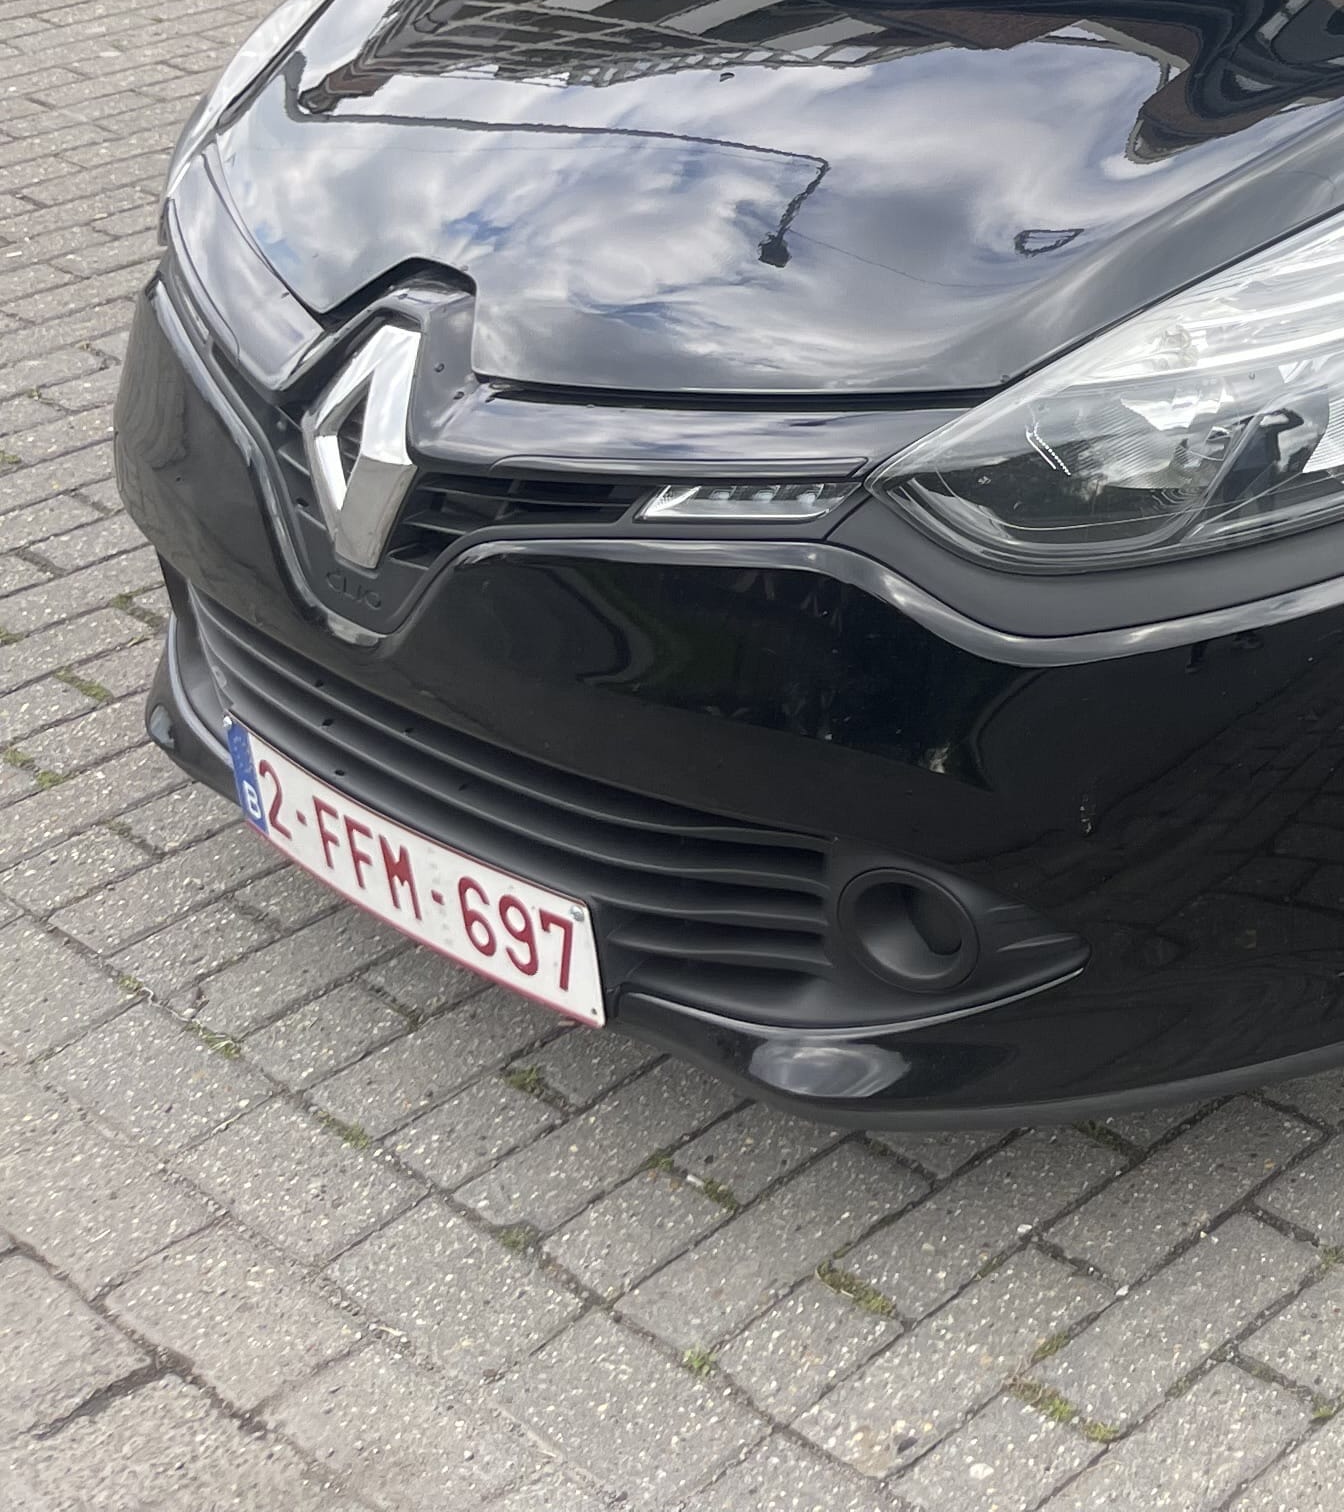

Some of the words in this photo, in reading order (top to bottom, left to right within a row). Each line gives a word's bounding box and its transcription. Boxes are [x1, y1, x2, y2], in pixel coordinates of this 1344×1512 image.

[325, 571, 382, 611] CLIO
[242, 779, 262, 820] B
[258, 758, 575, 992] 2-FFM-697
